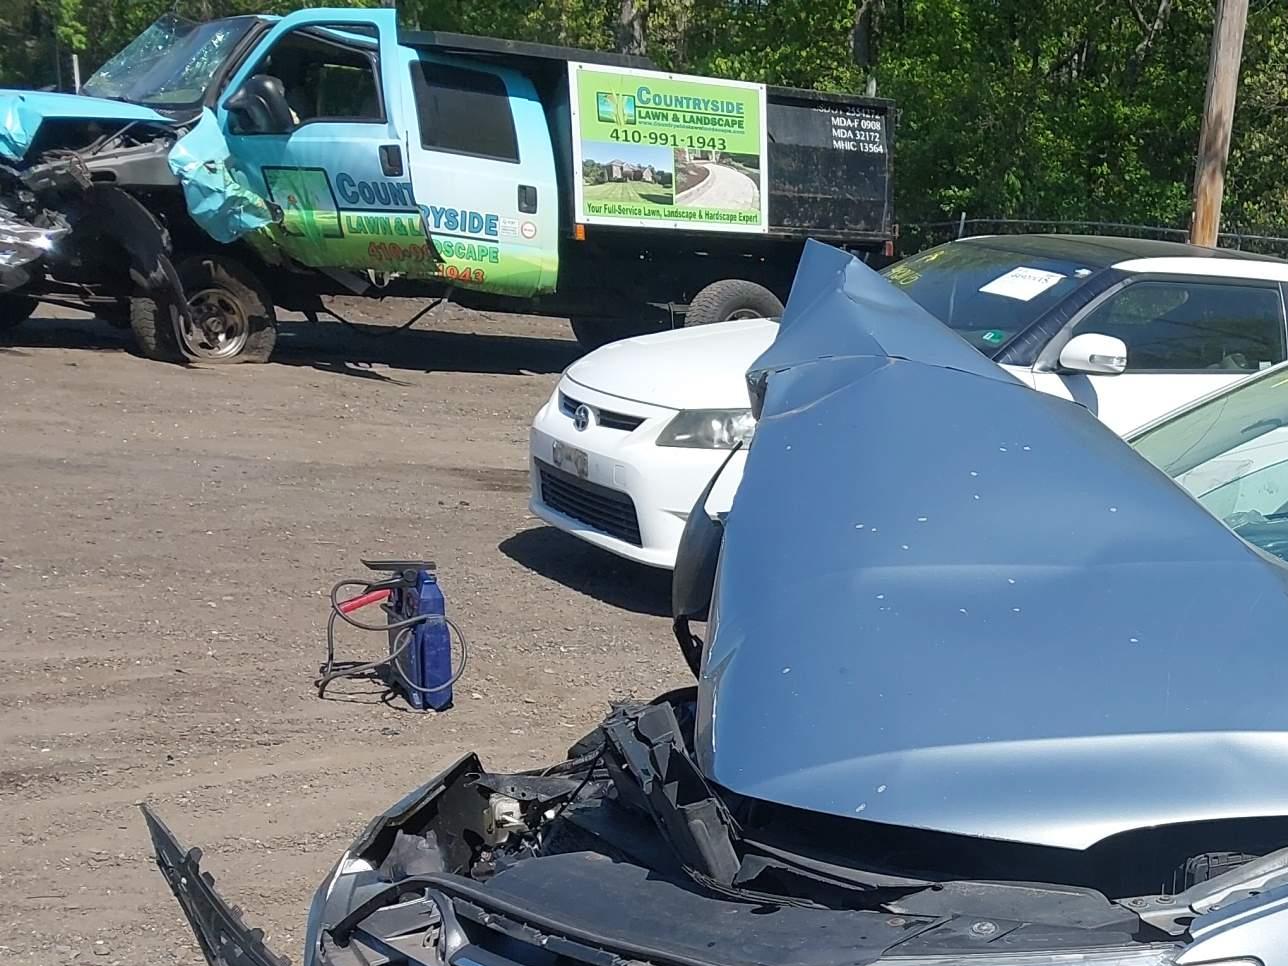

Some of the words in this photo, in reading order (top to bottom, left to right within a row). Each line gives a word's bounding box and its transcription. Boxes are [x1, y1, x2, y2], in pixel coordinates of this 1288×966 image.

[636, 86, 745, 115] COUNTRYSIDE
[637, 110, 669, 122] LAWN
[671, 113, 680, 123] &
[682, 114, 745, 129] LANDSCAPE
[831, 116, 860, 128] MDA-F
[861, 120, 881, 131] 0908
[609, 128, 727, 151] 410-991-1943
[832, 127, 854, 139] MDA
[855, 130, 880, 142] 32172
[833, 139, 858, 151] MHIC
[860, 142, 884, 154] 13564
[586, 202, 603, 214] Your
[603, 203, 642, 216] Full-Service
[643, 206, 662, 220] Lawn,
[663, 208, 697, 220] Landscape
[698, 209, 703, 220] &
[704, 210, 737, 222] Hardscape
[738, 212, 758, 224] Expert
[345, 215, 392, 236] LAWN
[393, 218, 409, 236] &
